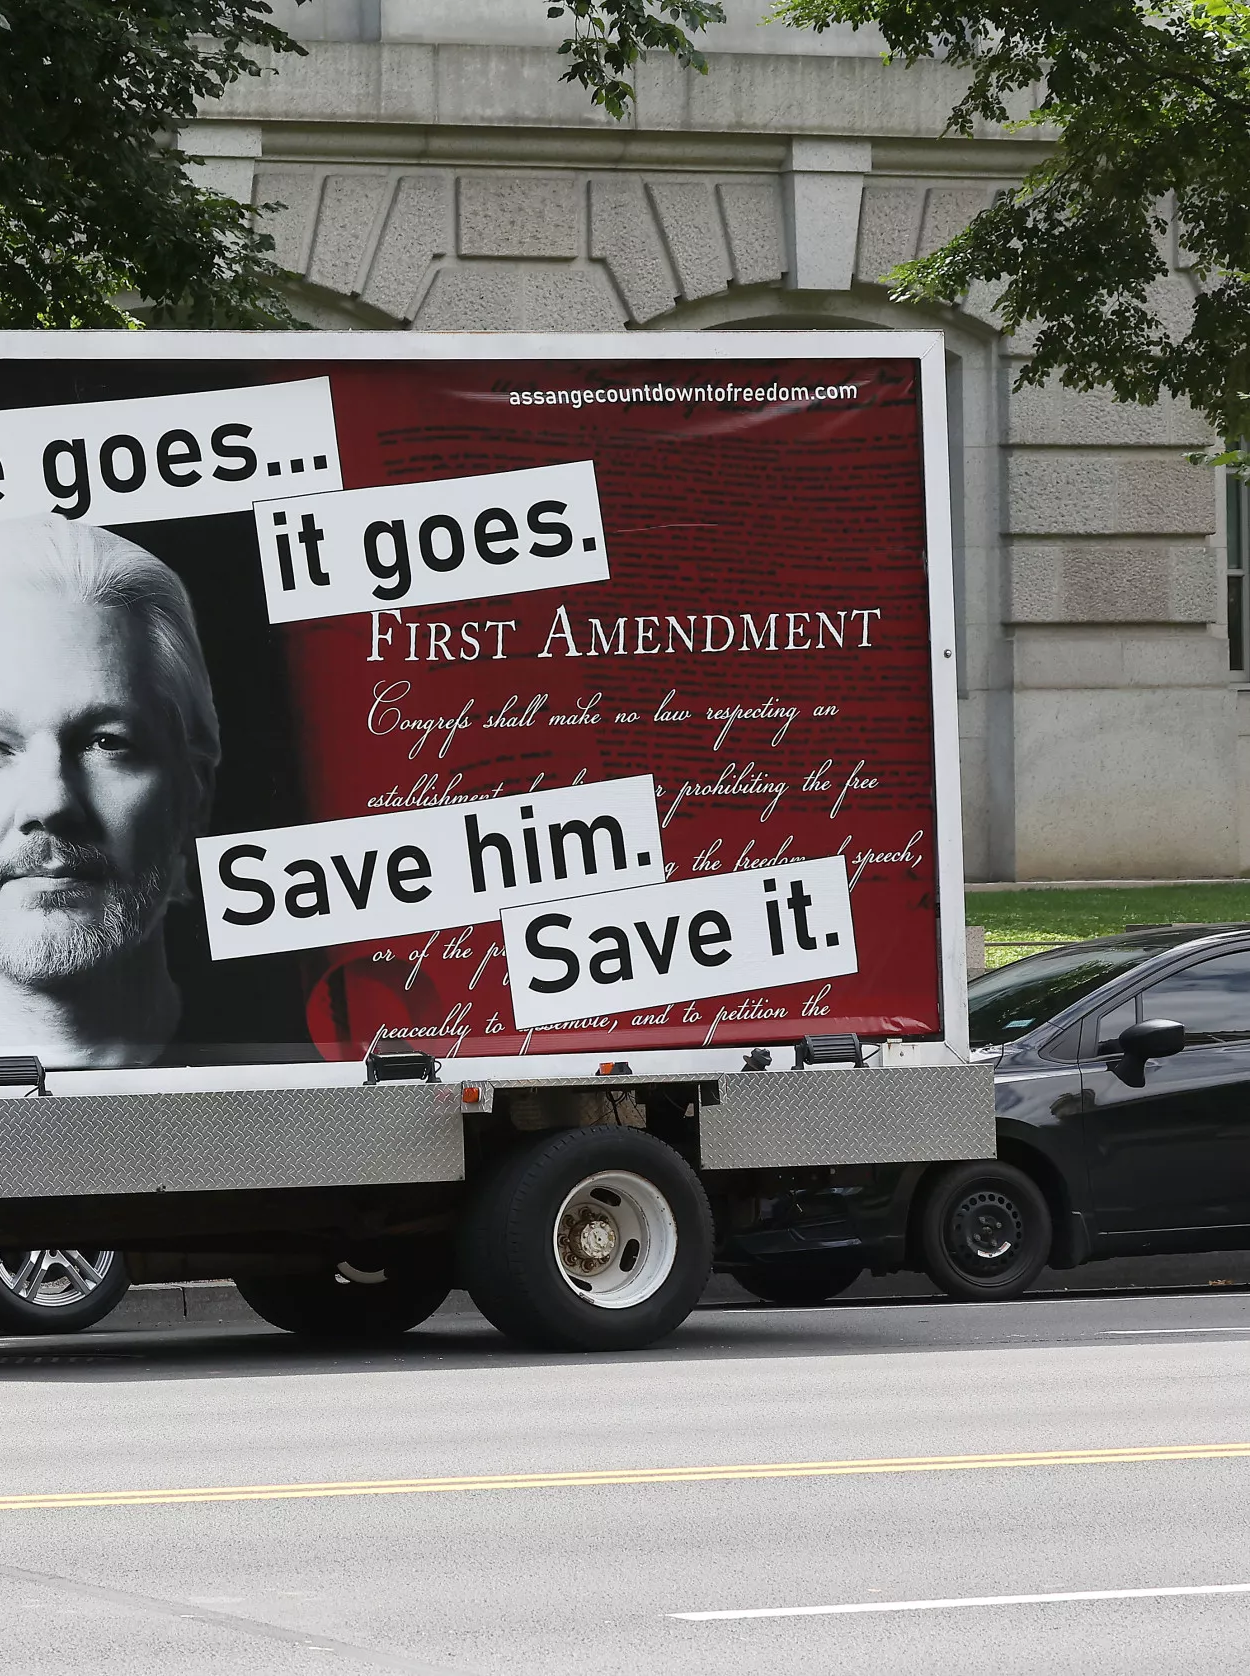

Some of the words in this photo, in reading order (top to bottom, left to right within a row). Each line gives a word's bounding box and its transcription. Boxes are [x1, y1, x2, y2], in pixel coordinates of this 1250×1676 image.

[509, 381, 858, 410] assangecountdowntofreedom.com
[42, 423, 329, 521] goes...
[272, 512, 330, 592] it
[364, 500, 597, 600] goes.
[482, 693, 549, 728] shall
[549, 692, 602, 726] make
[614, 710, 640, 723] no
[654, 689, 691, 721] law
[706, 697, 801, 751] respecting
[813, 704, 839, 716] an
[662, 762, 789, 828] prohibiting
[802, 759, 832, 791] the
[830, 760, 879, 819] free
[218, 844, 432, 926] Save
[464, 806, 652, 893] him.
[692, 839, 722, 871] the
[849, 830, 923, 893] speech,
[372, 949, 395, 962] or
[404, 930, 440, 991] of
[442, 926, 473, 960] the
[525, 913, 732, 994] Save
[764, 877, 840, 957] it.
[363, 1002, 472, 1060] peaceably
[485, 1012, 506, 1034] to
[631, 1003, 675, 1026] and
[682, 1001, 702, 1023] to
[702, 998, 788, 1048] petition
[801, 984, 832, 1017] the
